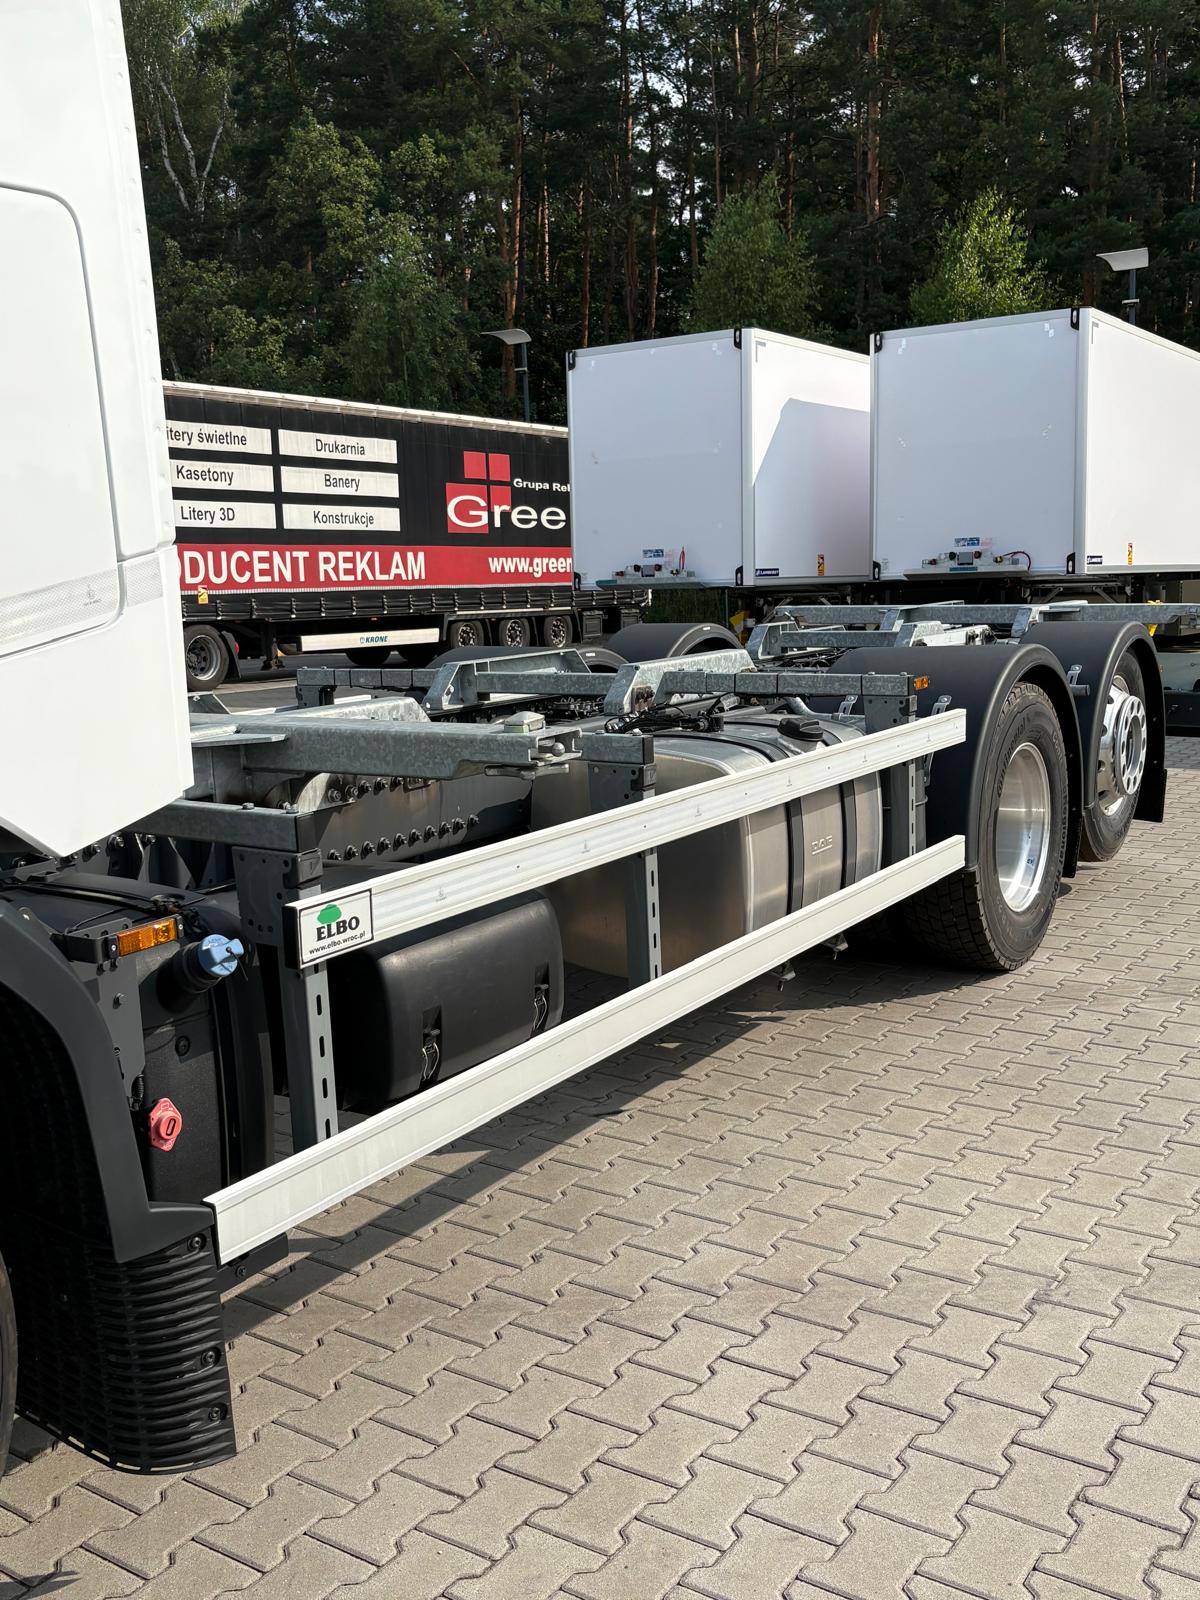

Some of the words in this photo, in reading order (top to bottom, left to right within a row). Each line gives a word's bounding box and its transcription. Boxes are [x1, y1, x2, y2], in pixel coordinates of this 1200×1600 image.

[197, 428, 247, 446] świetlne
[315, 438, 366, 456] Drukarnia
[176, 464, 234, 486] Kasetony
[324, 474, 360, 492] Banery
[513, 478, 550, 491] Grupa
[180, 506, 216, 524] Litery
[219, 507, 235, 522] 3D
[313, 510, 375, 528] Konstrukcje
[447, 495, 567, 529] Gree
[178, 550, 310, 584] DUCENT
[318, 551, 426, 582] REKLAM
[365, 635, 389, 644] KRONE
[316, 916, 360, 942] ELBO
[308, 930, 366, 955] www.elbo.wroc.pl
